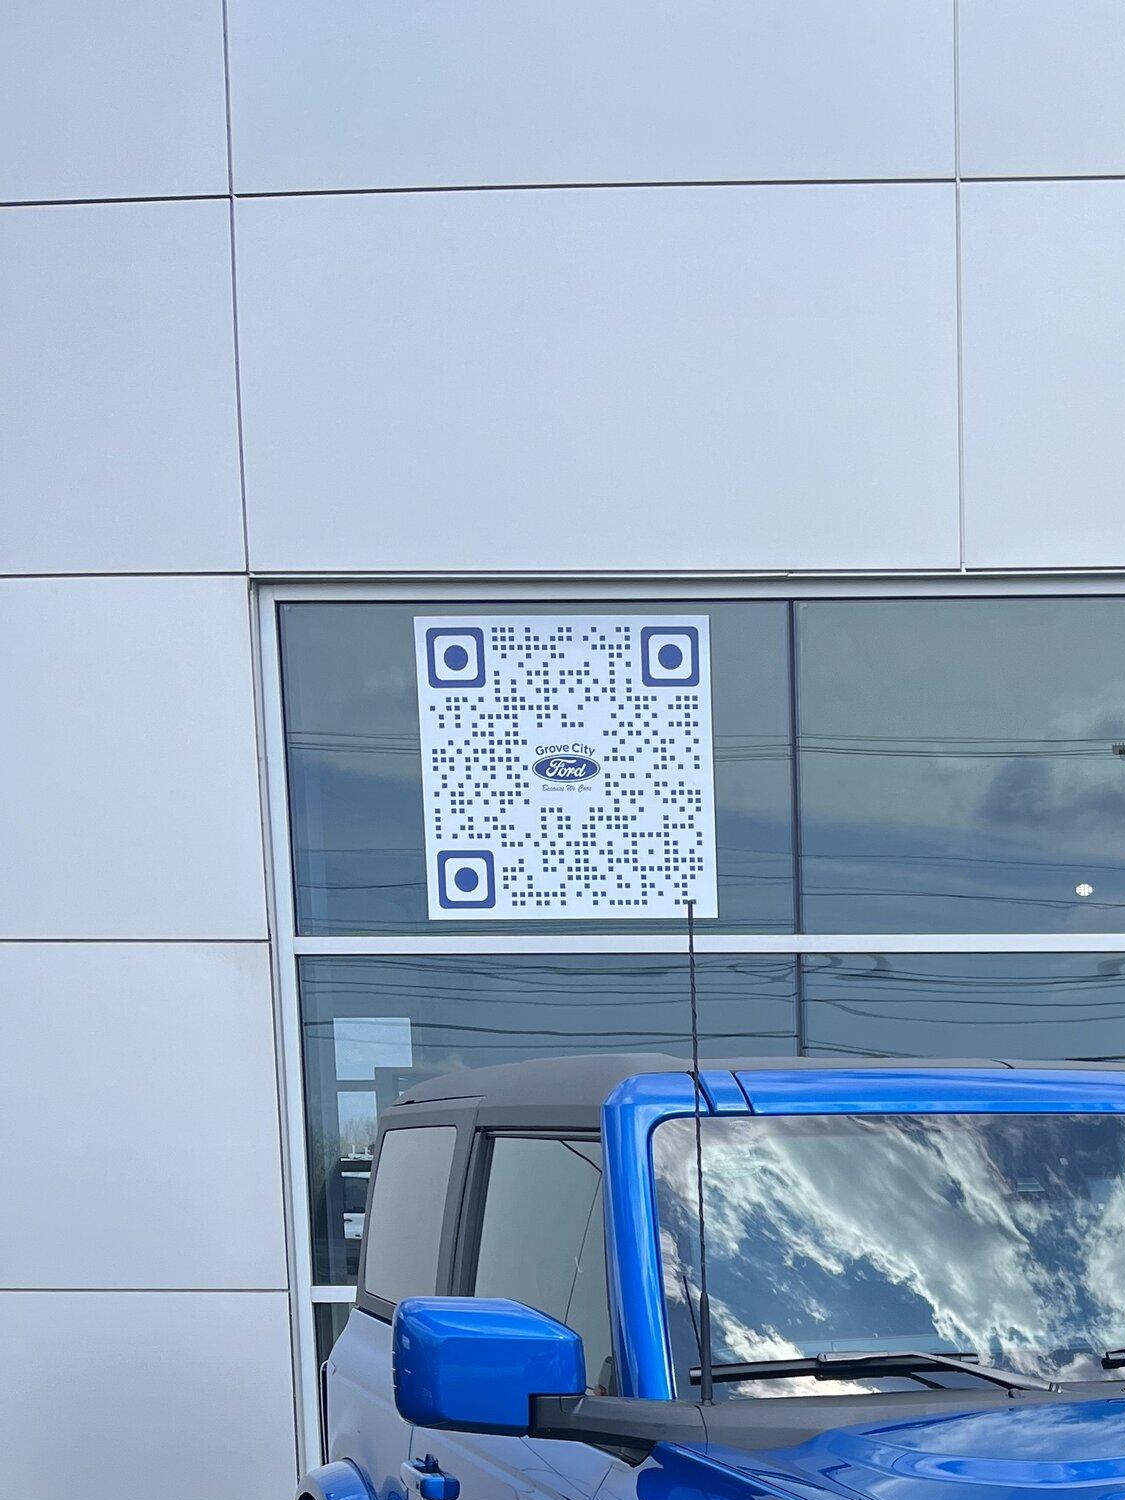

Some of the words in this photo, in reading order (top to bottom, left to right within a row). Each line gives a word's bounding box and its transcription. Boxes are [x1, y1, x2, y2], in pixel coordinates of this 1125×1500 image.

[535, 744, 569, 755] Grove
[572, 743, 595, 757] City
[545, 758, 587, 778] Ford
